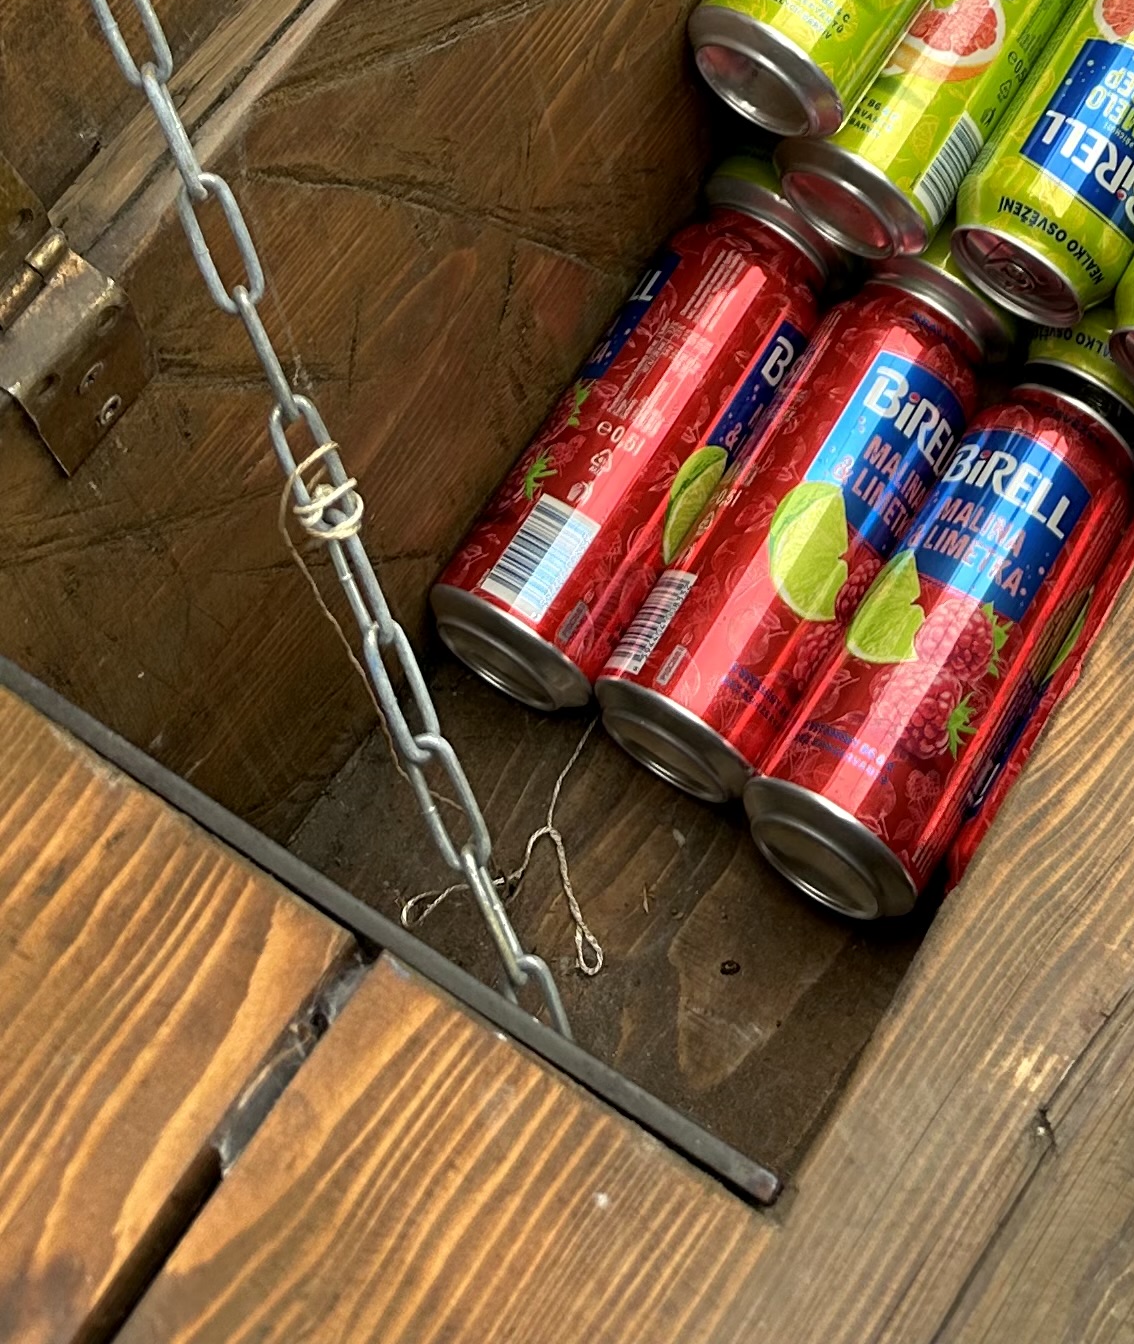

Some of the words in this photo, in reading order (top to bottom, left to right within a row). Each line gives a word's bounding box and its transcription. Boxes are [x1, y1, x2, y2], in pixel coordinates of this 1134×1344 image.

[999, 196, 1067, 241] OSVĚŽENÍ
[1067, 239, 1105, 285] NEALKO
[863, 434, 928, 509] MALINA
[942, 443, 1070, 540] BiRELL
[936, 496, 1026, 558] MALINA
[924, 525, 1024, 597] LIMETKA
